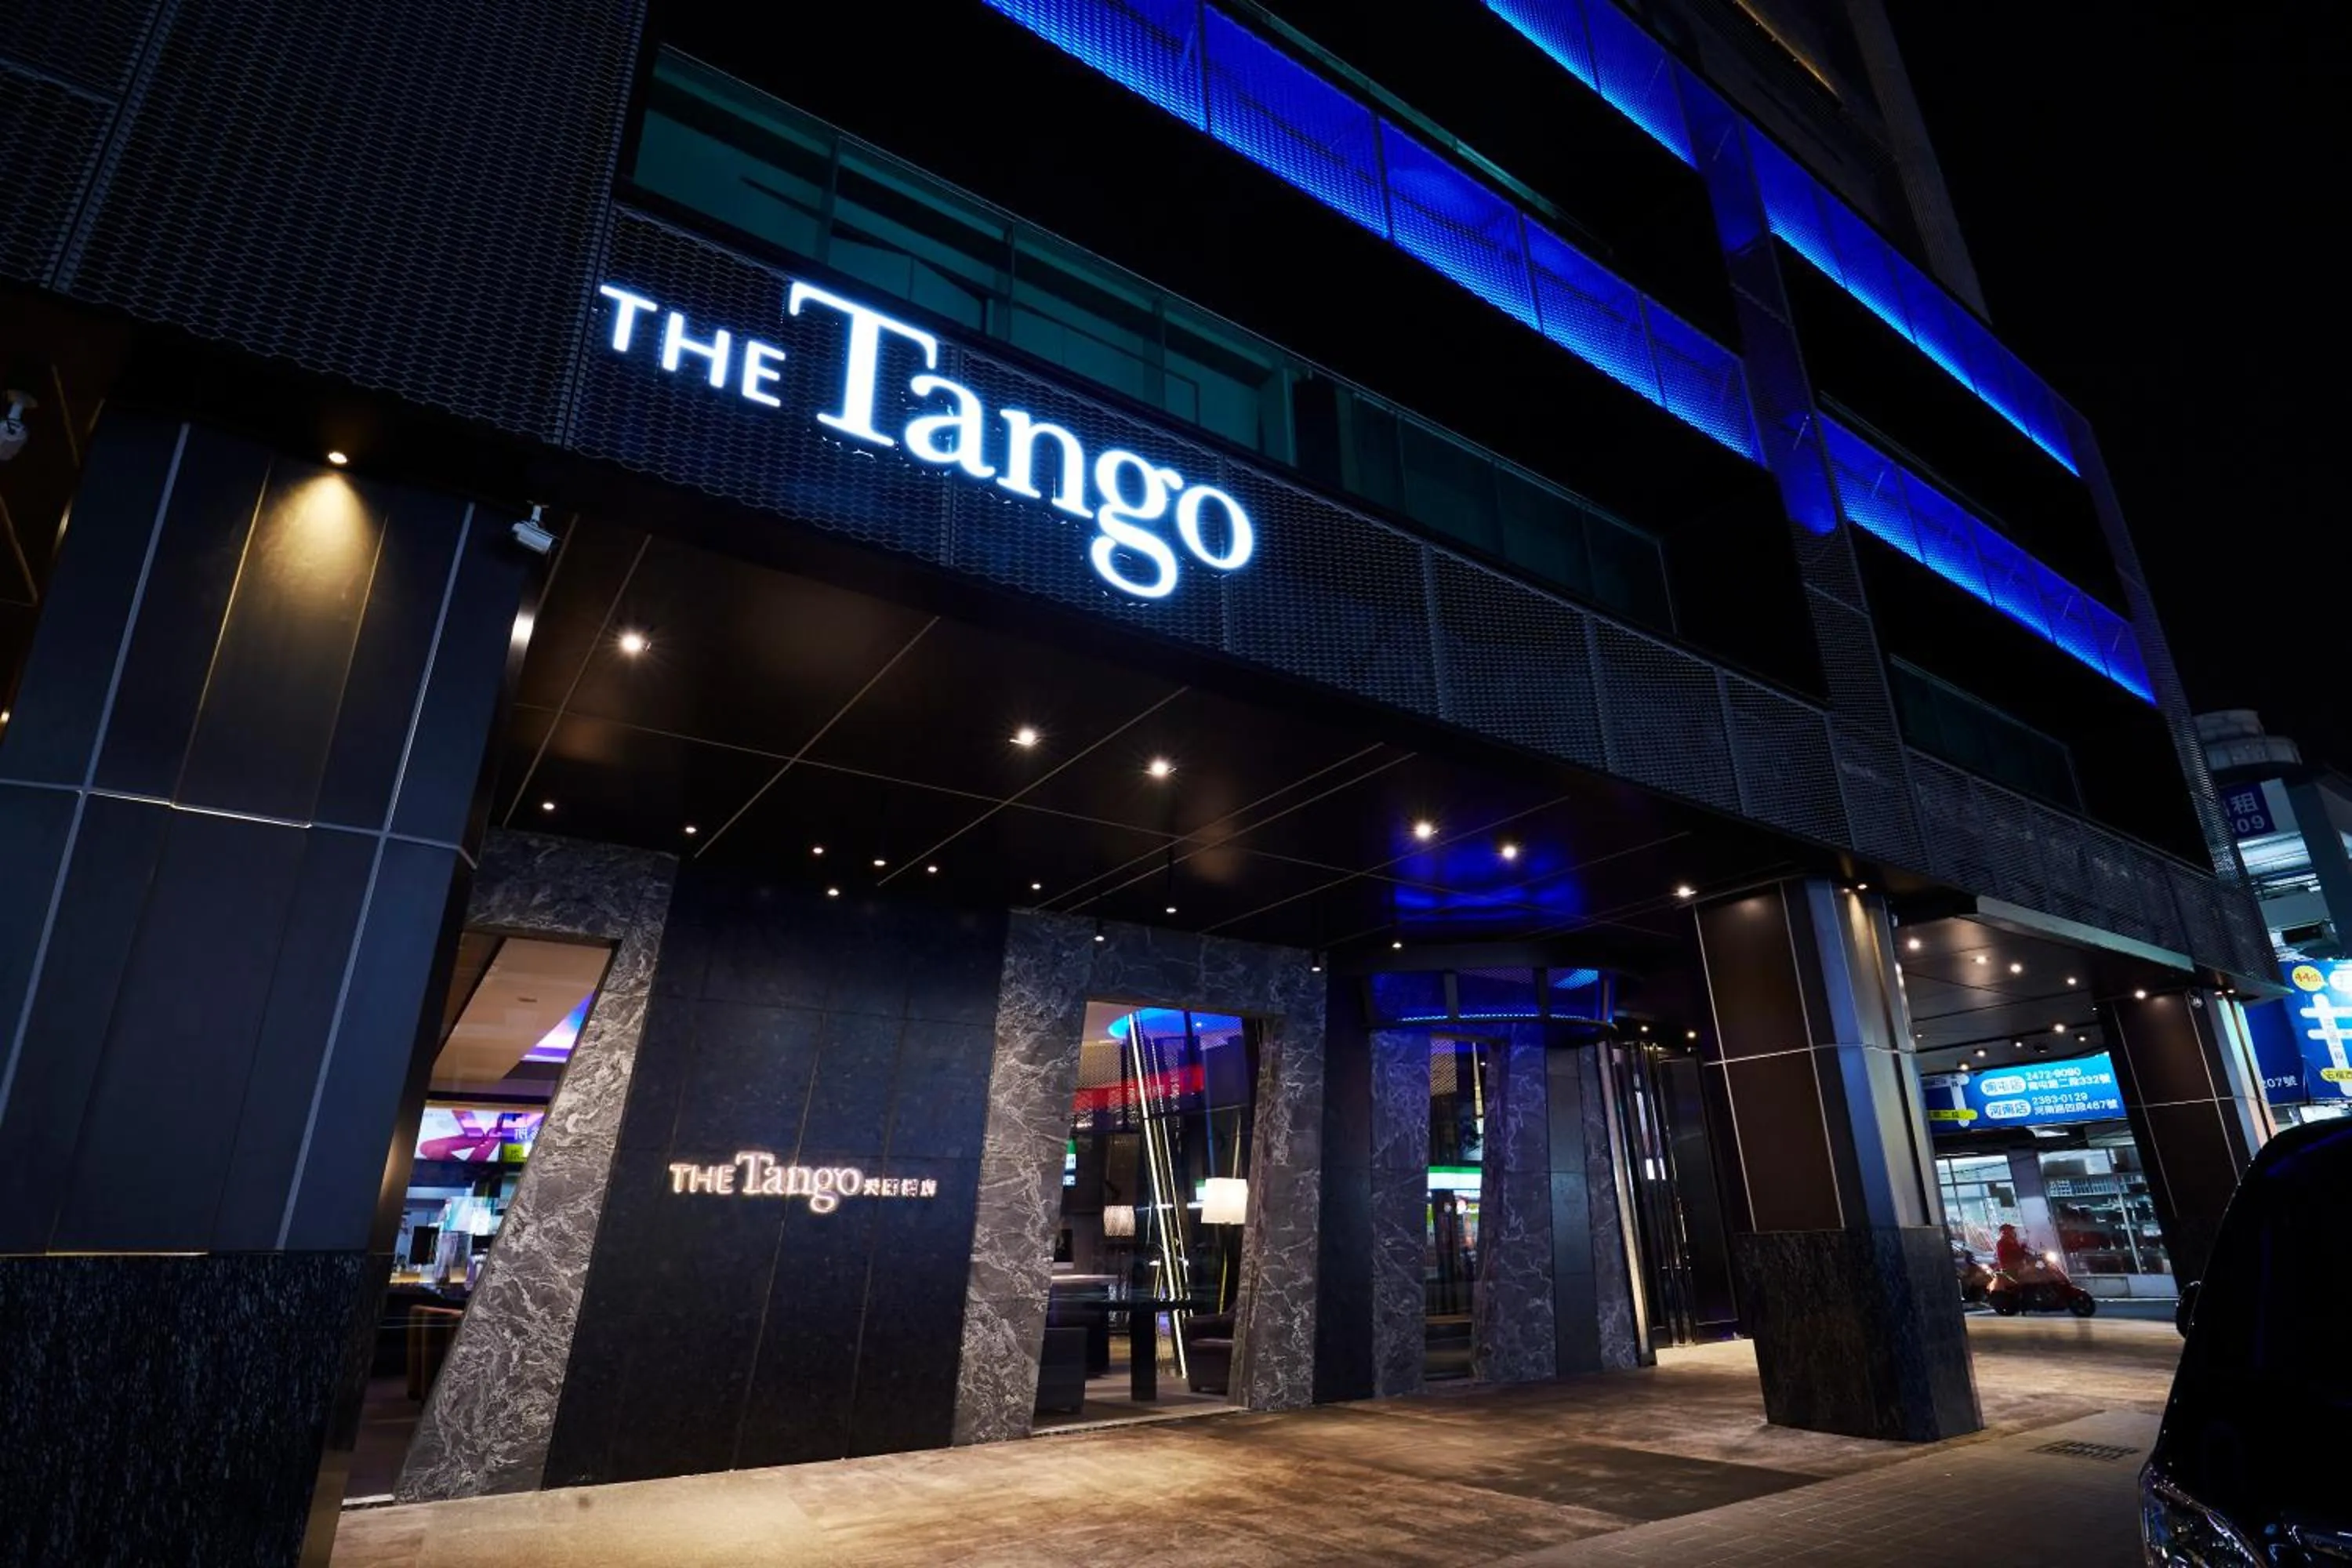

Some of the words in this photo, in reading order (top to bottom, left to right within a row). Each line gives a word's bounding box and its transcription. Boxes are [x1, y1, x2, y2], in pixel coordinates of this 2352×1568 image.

[599, 285, 786, 408] THE
[789, 281, 1254, 599] Tango
[2223, 791, 2259, 817] 租
[2230, 814, 2266, 834] 09
[669, 1162, 736, 1195] THE
[735, 1150, 863, 1214] Tango
